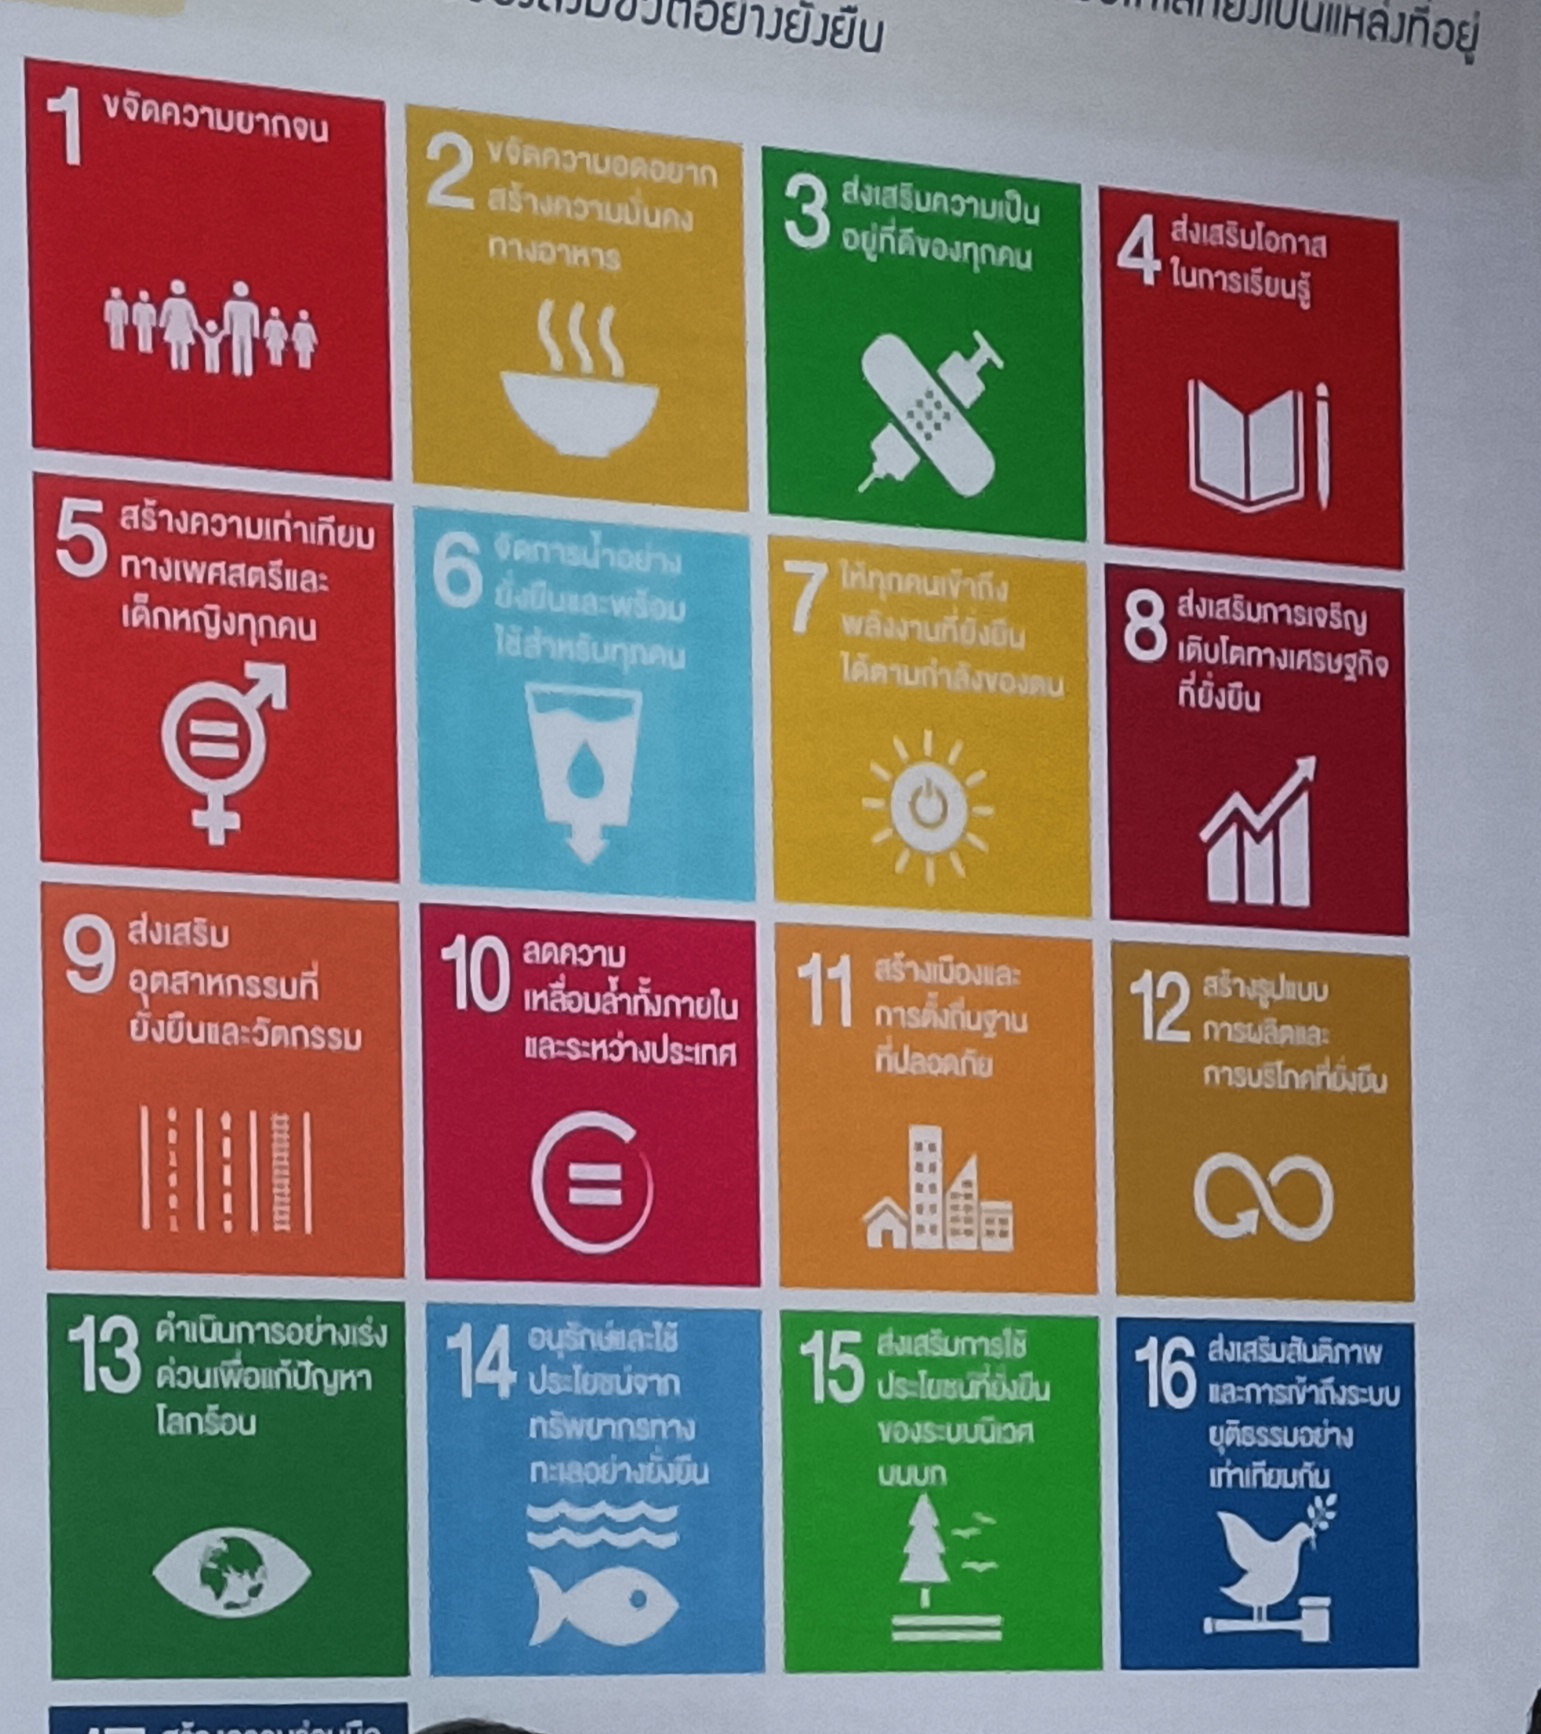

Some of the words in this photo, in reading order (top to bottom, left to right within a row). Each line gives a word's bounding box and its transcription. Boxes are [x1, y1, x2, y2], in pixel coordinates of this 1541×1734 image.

[46, 86, 81, 166] 1
[103, 88, 329, 143] ขจัดความยากจน
[426, 131, 475, 210] 2
[785, 172, 831, 250] 3
[842, 174, 1041, 226] ส่งเสริมความเป็น
[489, 235, 622, 272] ทางอาหาร
[842, 217, 1034, 274] อยู่ที่ดีของทุกคน
[1116, 213, 1162, 286] 4
[1171, 213, 1327, 258] ส่งเสริมโอกาส
[1170, 256, 1311, 310] ในการเรียนรู้
[56, 496, 108, 578] 5
[119, 497, 375, 550] สร้างความเท่าเทียม
[121, 554, 330, 592] ทางเพศสตรีและ
[432, 531, 483, 607] 6
[122, 592, 317, 647] เด็กหญิงทุกคน
[784, 560, 829, 633] 7
[1177, 588, 1367, 637] ส่งเสริมการเจริญ
[1124, 588, 1168, 662] 8
[1178, 635, 1390, 682] เติบโตทางเศรษฐกิจ
[1178, 670, 1261, 712] ที่ยั่งยืน
[63, 913, 116, 994] 9
[128, 911, 229, 949] ส่งเสริม
[441, 934, 511, 1013] 10
[523, 940, 626, 968] ลดความ
[875, 950, 1022, 987] สร้างเมืองและ
[128, 959, 319, 1009] อุตสาหกรรมที่
[524, 973, 739, 1020] เหลื่อมล้ำทั้งภายใน
[797, 952, 852, 1028] 11
[1130, 969, 1191, 1043] 12
[1203, 967, 1329, 1009] สร้างรูปแบบ
[875, 991, 1028, 1038] การตั้งถิ่นฐาน
[1203, 1016, 1329, 1047] การผลิตและ
[525, 1031, 738, 1067] และระหว่างประเทศ
[875, 1034, 993, 1078] ที่ปลอดภัย
[156, 1311, 388, 1347] ดำเนินการอย่างเร่ง
[877, 1326, 1028, 1359] ส่งเสริมการใช้
[1208, 1332, 1383, 1365] ส่งเสริมสันติภาพ
[68, 1314, 141, 1393] 13
[156, 1348, 372, 1396] ด่วนเพื่อแก้ปัญหา
[447, 1322, 518, 1399] 14
[800, 1329, 865, 1404] 15
[1135, 1335, 1197, 1409] 16
[528, 1363, 681, 1397] ประโยชน์จาก
[156, 1403, 257, 1436] โลกร้อน
[529, 1410, 696, 1441] ทรัพยากรทาง
[878, 1415, 1035, 1444] ของระบบนิเวศ
[1209, 1418, 1354, 1457] ยุติธรรมอย่าง
[530, 1447, 710, 1485] ทะเลอย่างยั่งยืน
[878, 1464, 948, 1487] บนบก
[1209, 1459, 1331, 1490] เท่าเทียมกัน
